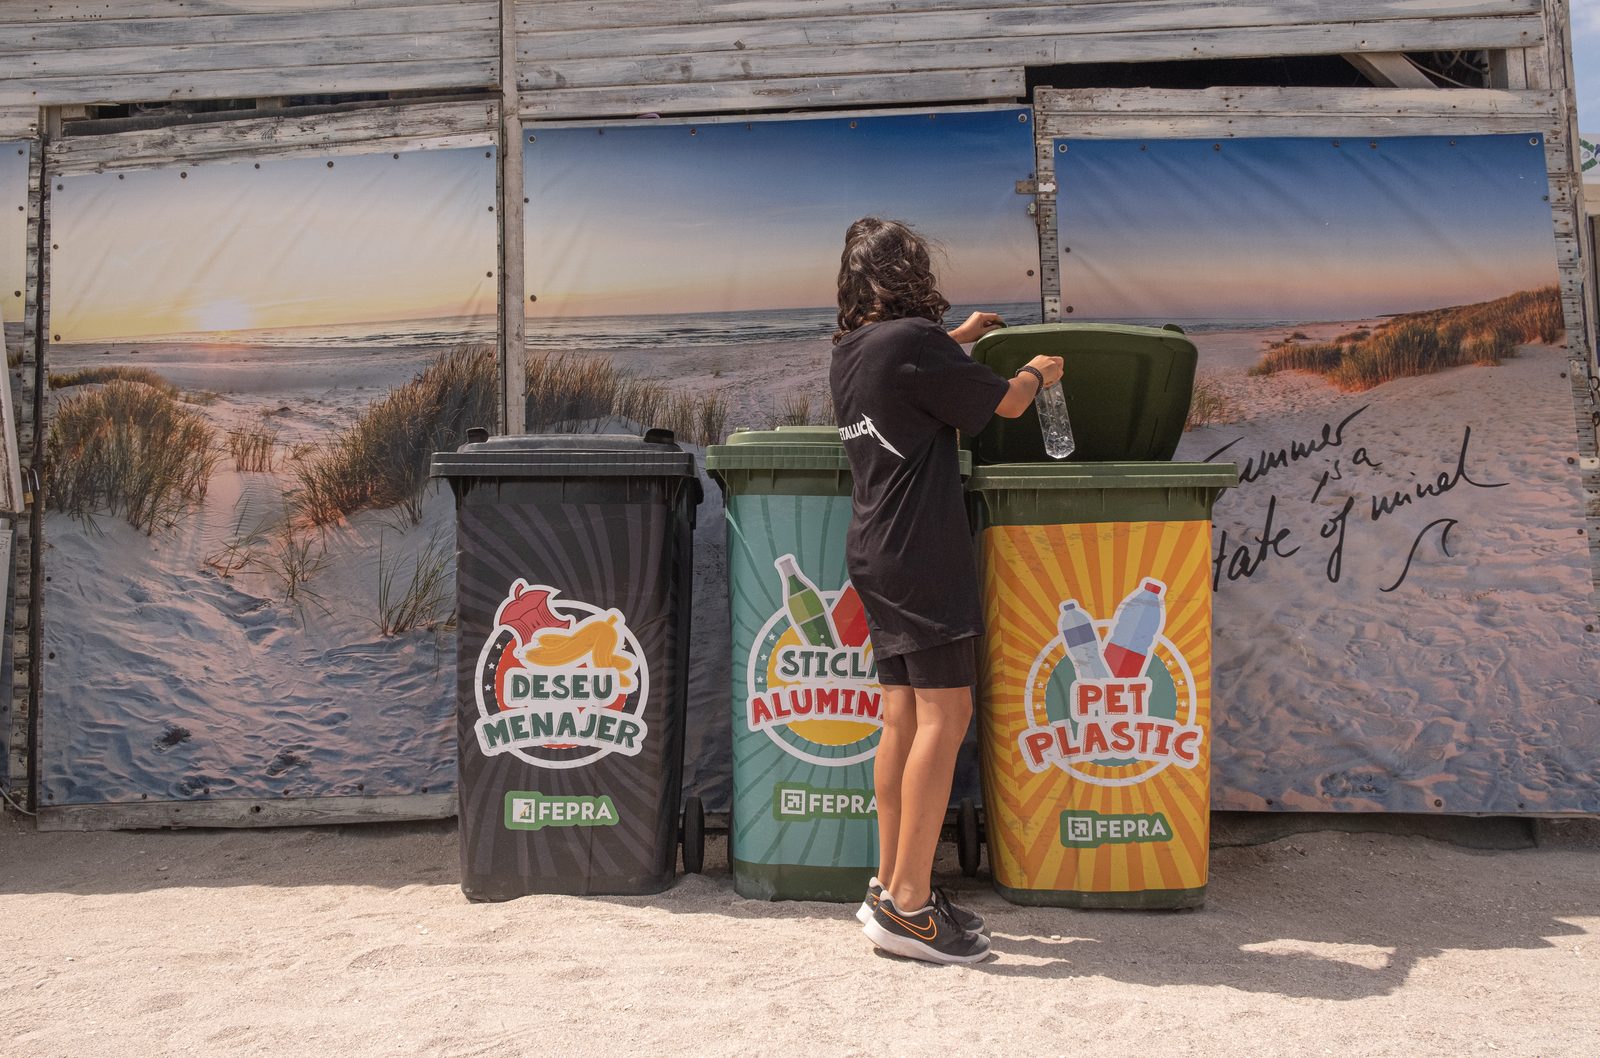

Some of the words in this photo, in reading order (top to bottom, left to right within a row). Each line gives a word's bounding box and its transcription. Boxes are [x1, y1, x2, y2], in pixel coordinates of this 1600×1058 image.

[1311, 459, 1342, 504] is
[1352, 447, 1383, 467] a
[1212, 494, 1301, 593] tate
[1320, 496, 1355, 583] of
[1371, 426, 1510, 521] mind
[510, 674, 613, 701] DESEU
[1076, 683, 1147, 716] PET
[751, 687, 884, 727] ALUMIN
[481, 711, 641, 750] MENAJER
[1024, 720, 1199, 767] PLASTIC
[538, 801, 613, 821] FEPRA
[808, 793, 878, 814] FEPRA
[1095, 818, 1168, 839] FEPRA
